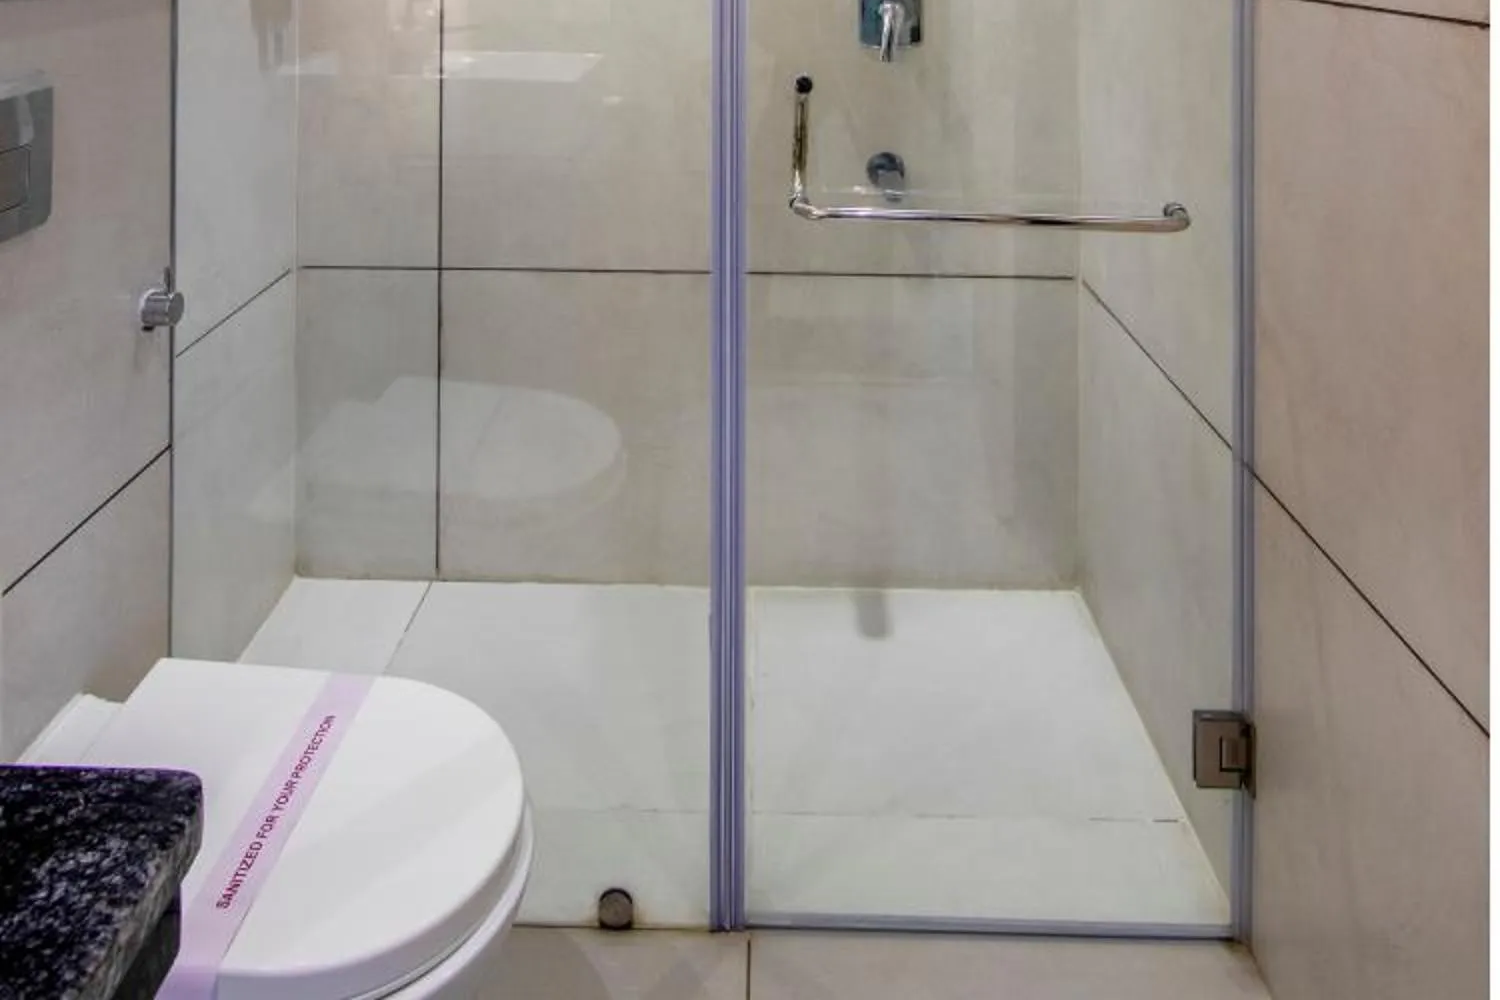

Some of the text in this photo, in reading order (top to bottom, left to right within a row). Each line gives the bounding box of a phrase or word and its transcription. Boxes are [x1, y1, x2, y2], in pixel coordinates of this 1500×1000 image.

[216, 714, 337, 910] SANITIZED FOR YOUR PROTECTION
